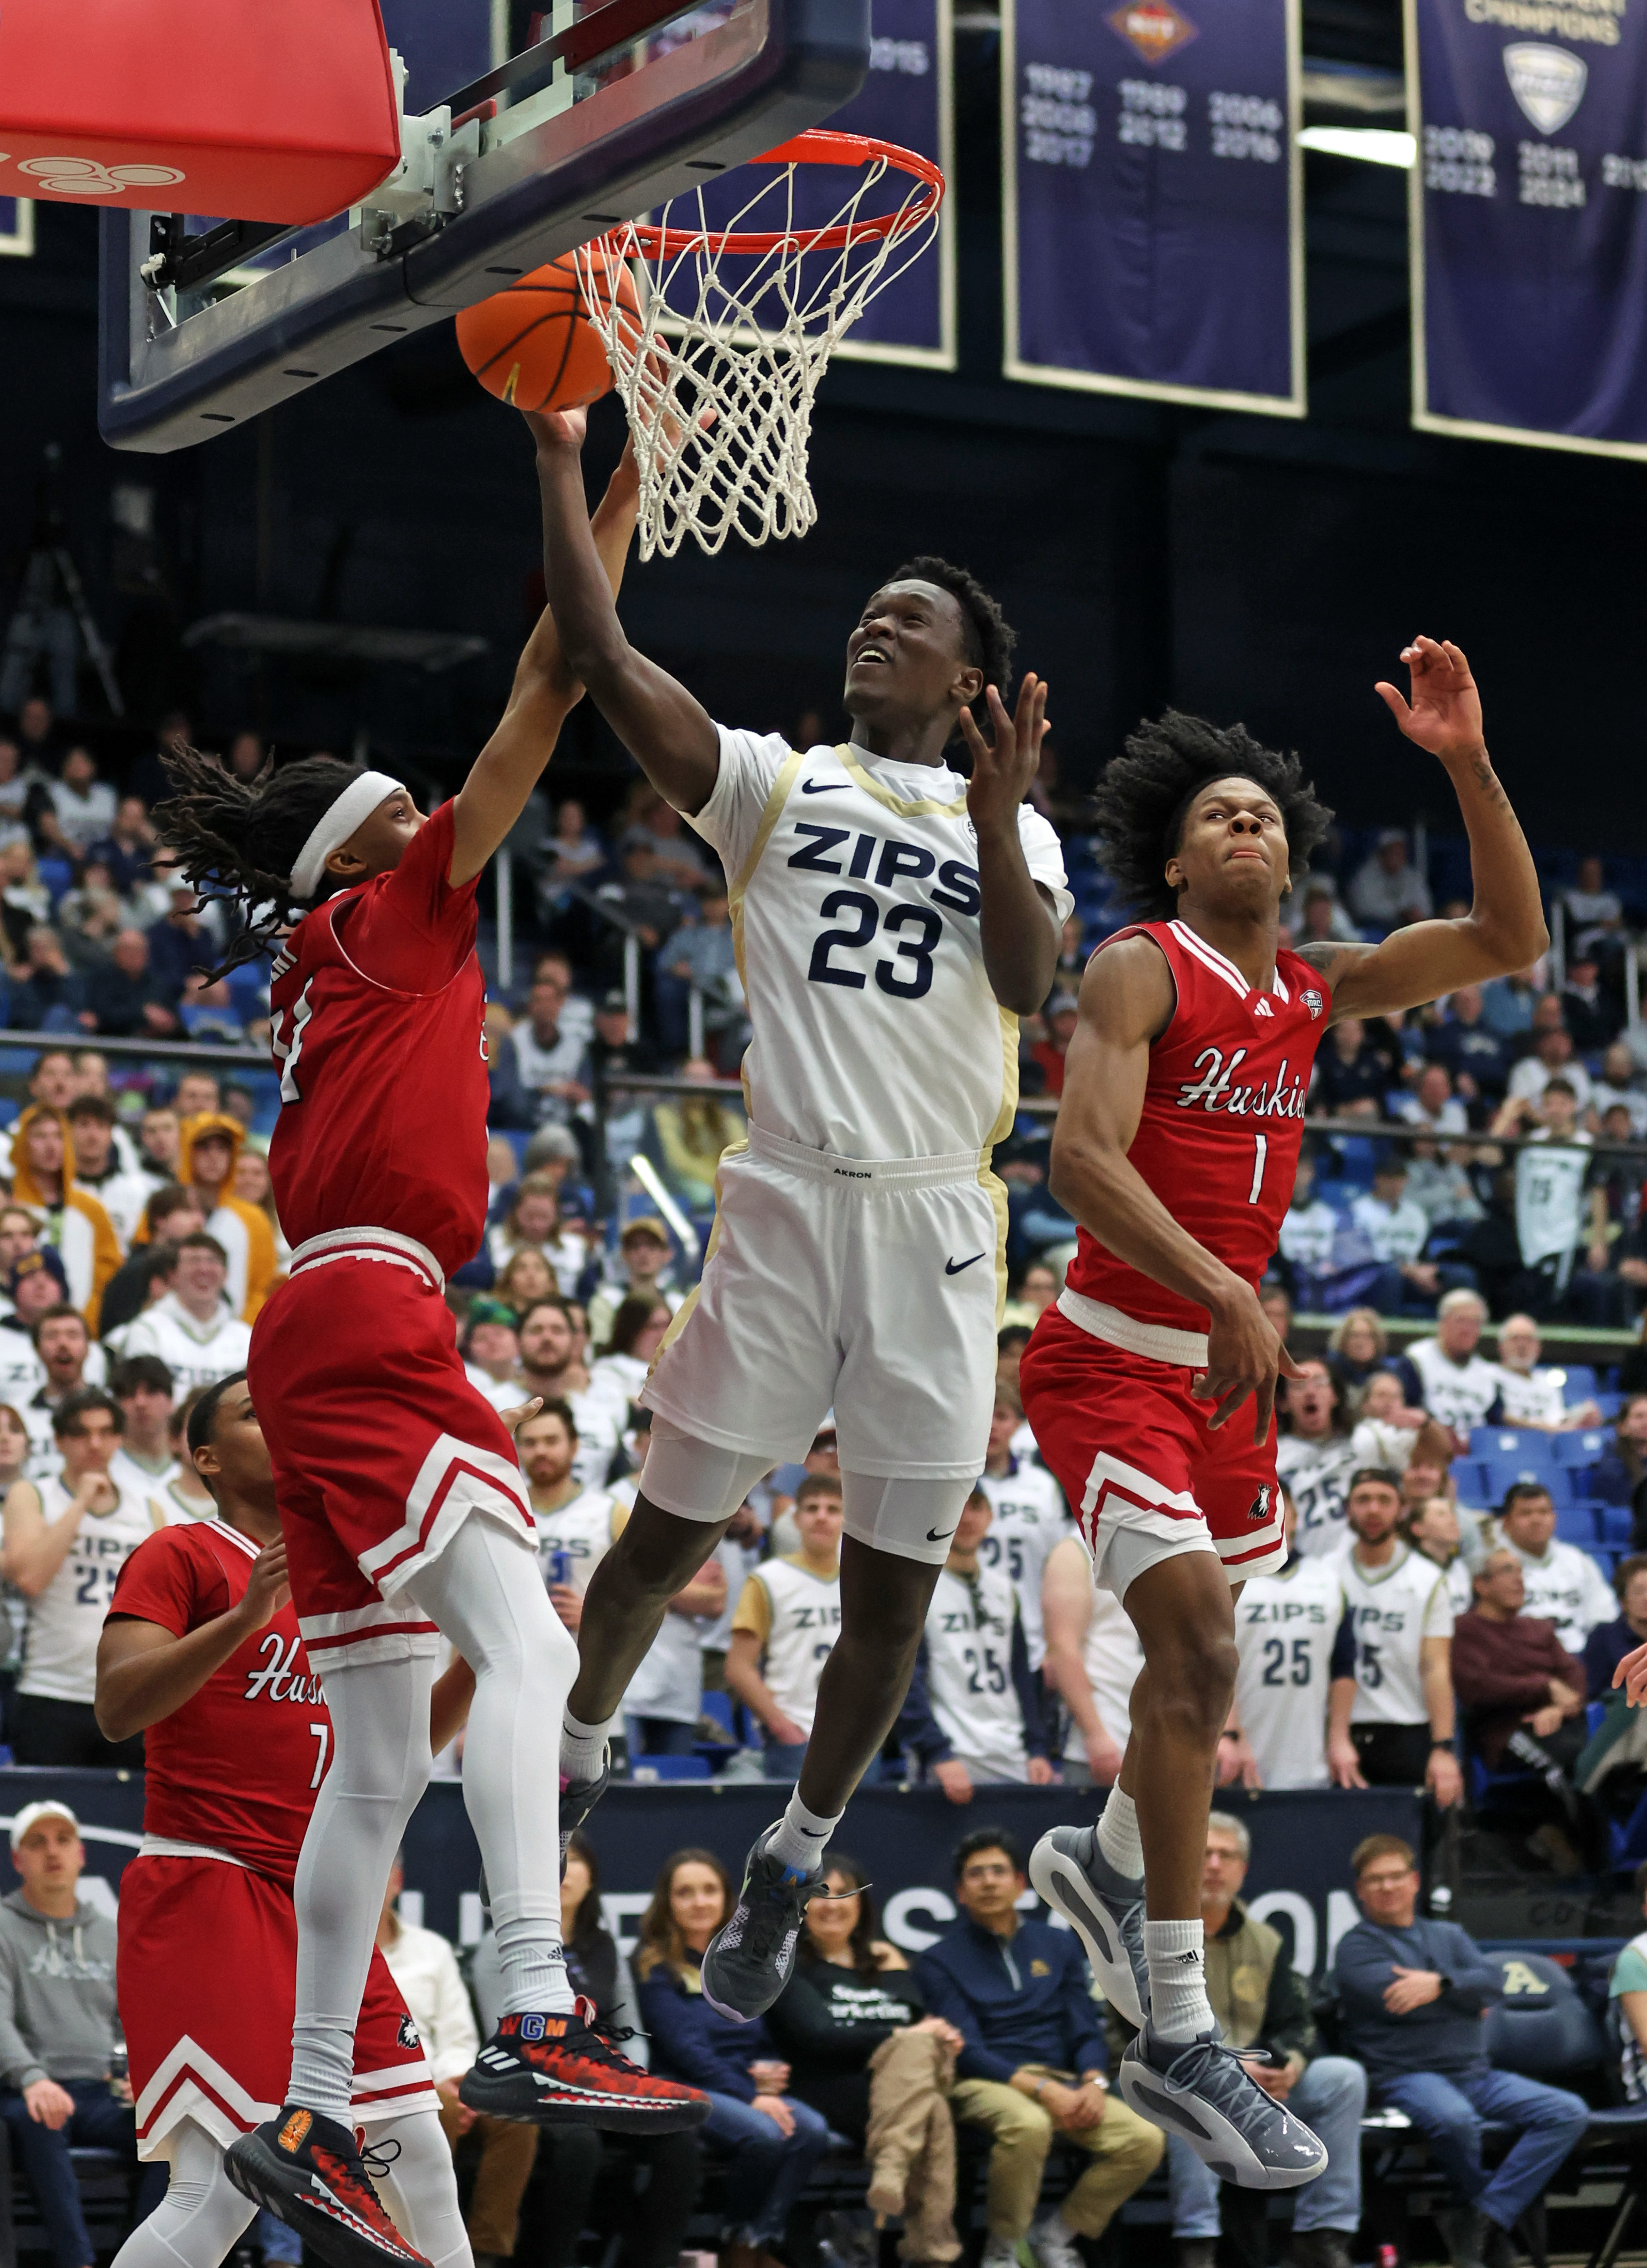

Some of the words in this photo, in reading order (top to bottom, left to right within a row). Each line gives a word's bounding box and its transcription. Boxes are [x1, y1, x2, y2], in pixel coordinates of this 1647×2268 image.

[787, 822, 981, 917] ZIPS
[808, 889, 943, 999] 23
[1176, 1046, 1305, 1119] Huskie
[833, 1168, 872, 1179] AKRON
[1248, 1133, 1268, 1205] 1
[791, 1607, 841, 1628] ZIP
[1245, 1602, 1326, 1624] ZIPS
[964, 1648, 1006, 1695] 25
[1263, 1638, 1312, 1686] 25
[1362, 1643, 1384, 1690] 5
[309, 1723, 329, 1789] 7
[1502, 1960, 1549, 1995] A
